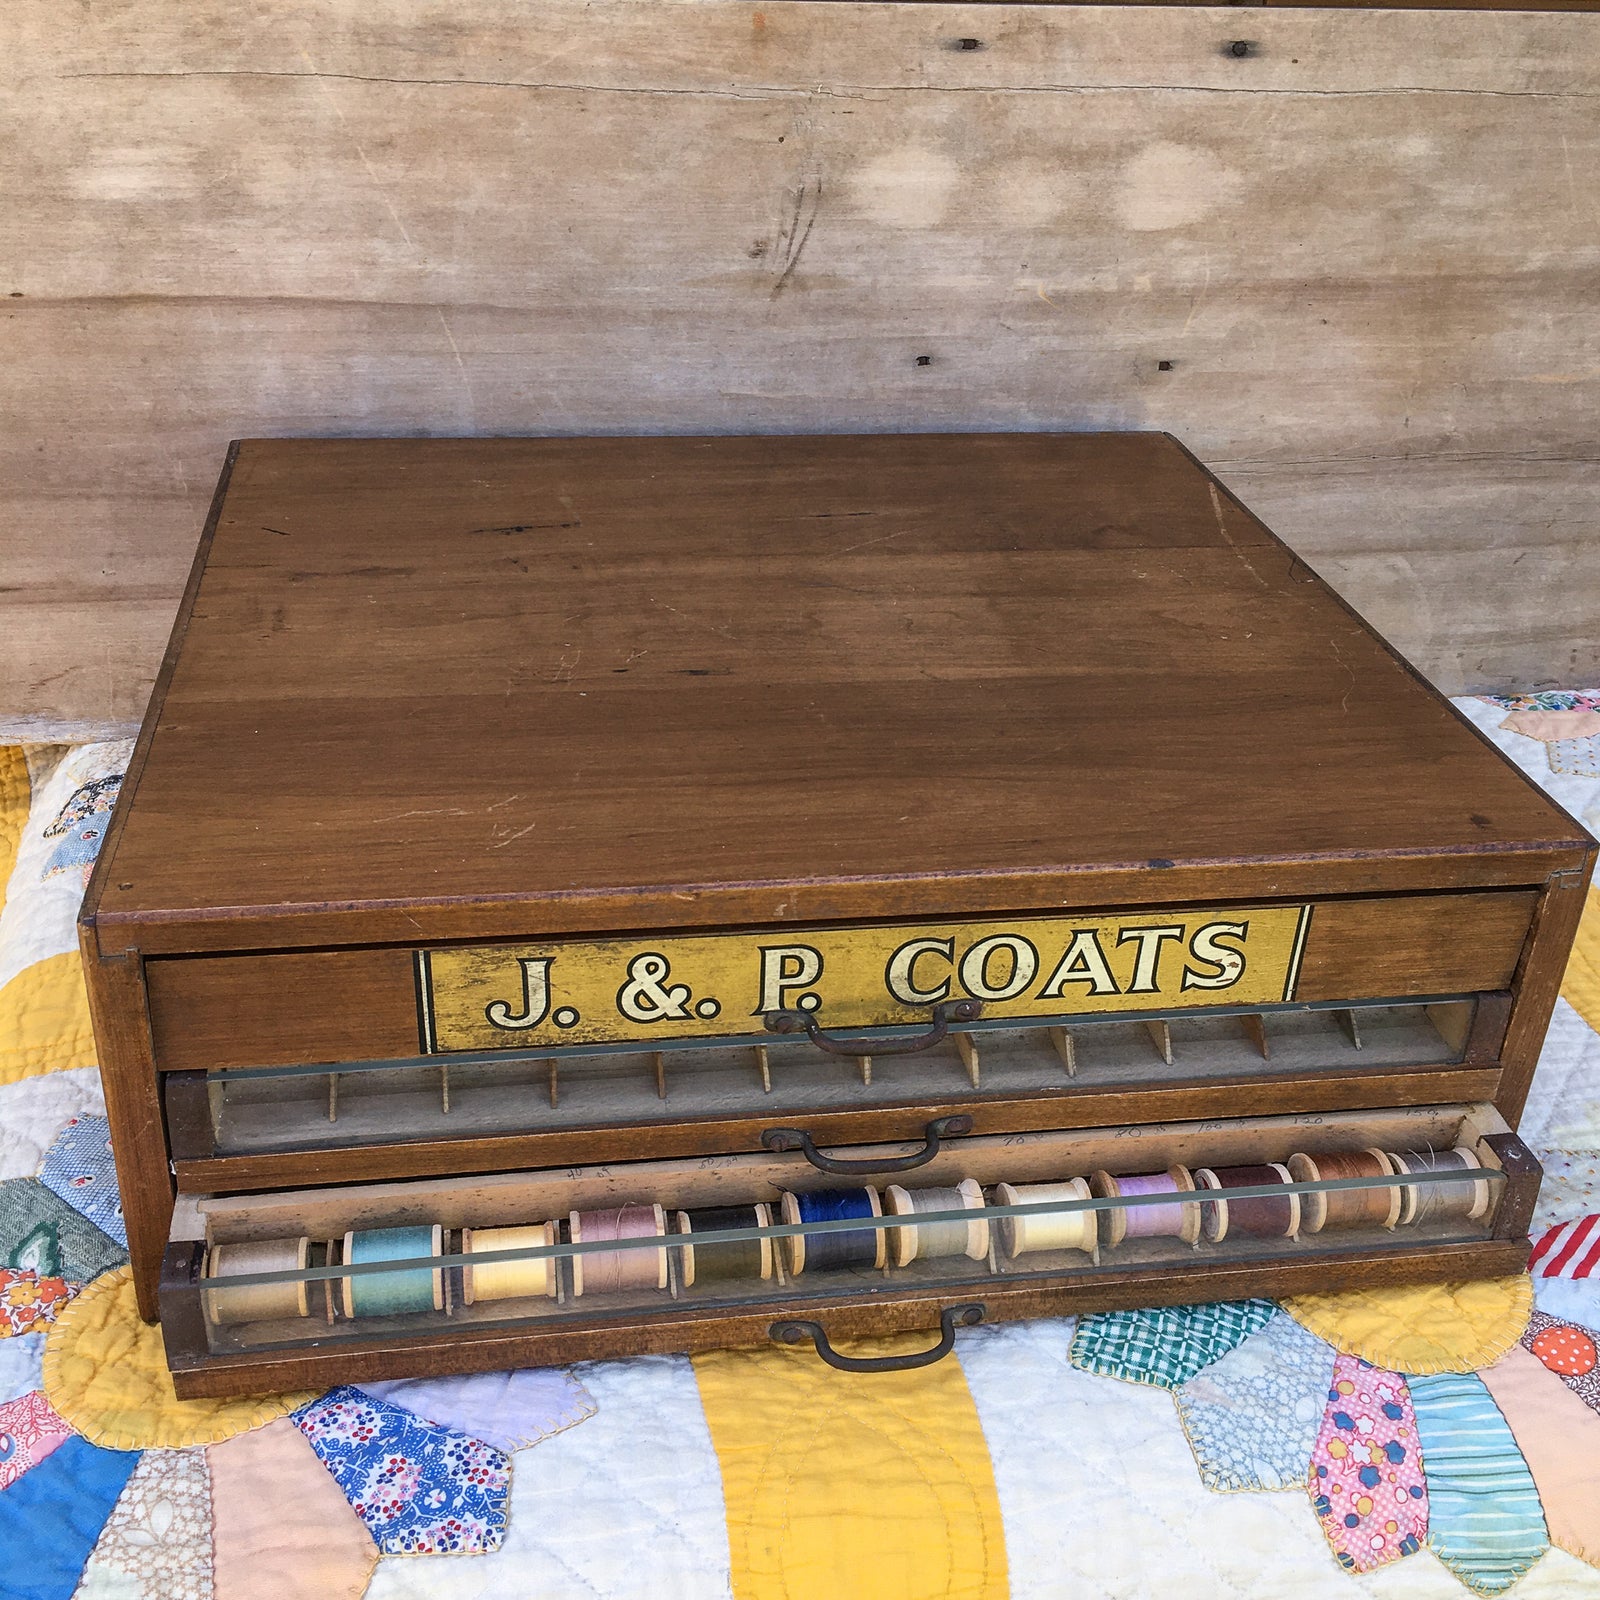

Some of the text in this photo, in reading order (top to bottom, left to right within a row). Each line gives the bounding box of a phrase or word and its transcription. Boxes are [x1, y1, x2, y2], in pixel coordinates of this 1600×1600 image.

[485, 920, 1249, 1031] J. &. P. COATS
[1293, 1116, 1323, 1125] 120
[1115, 1126, 1142, 1139] 80
